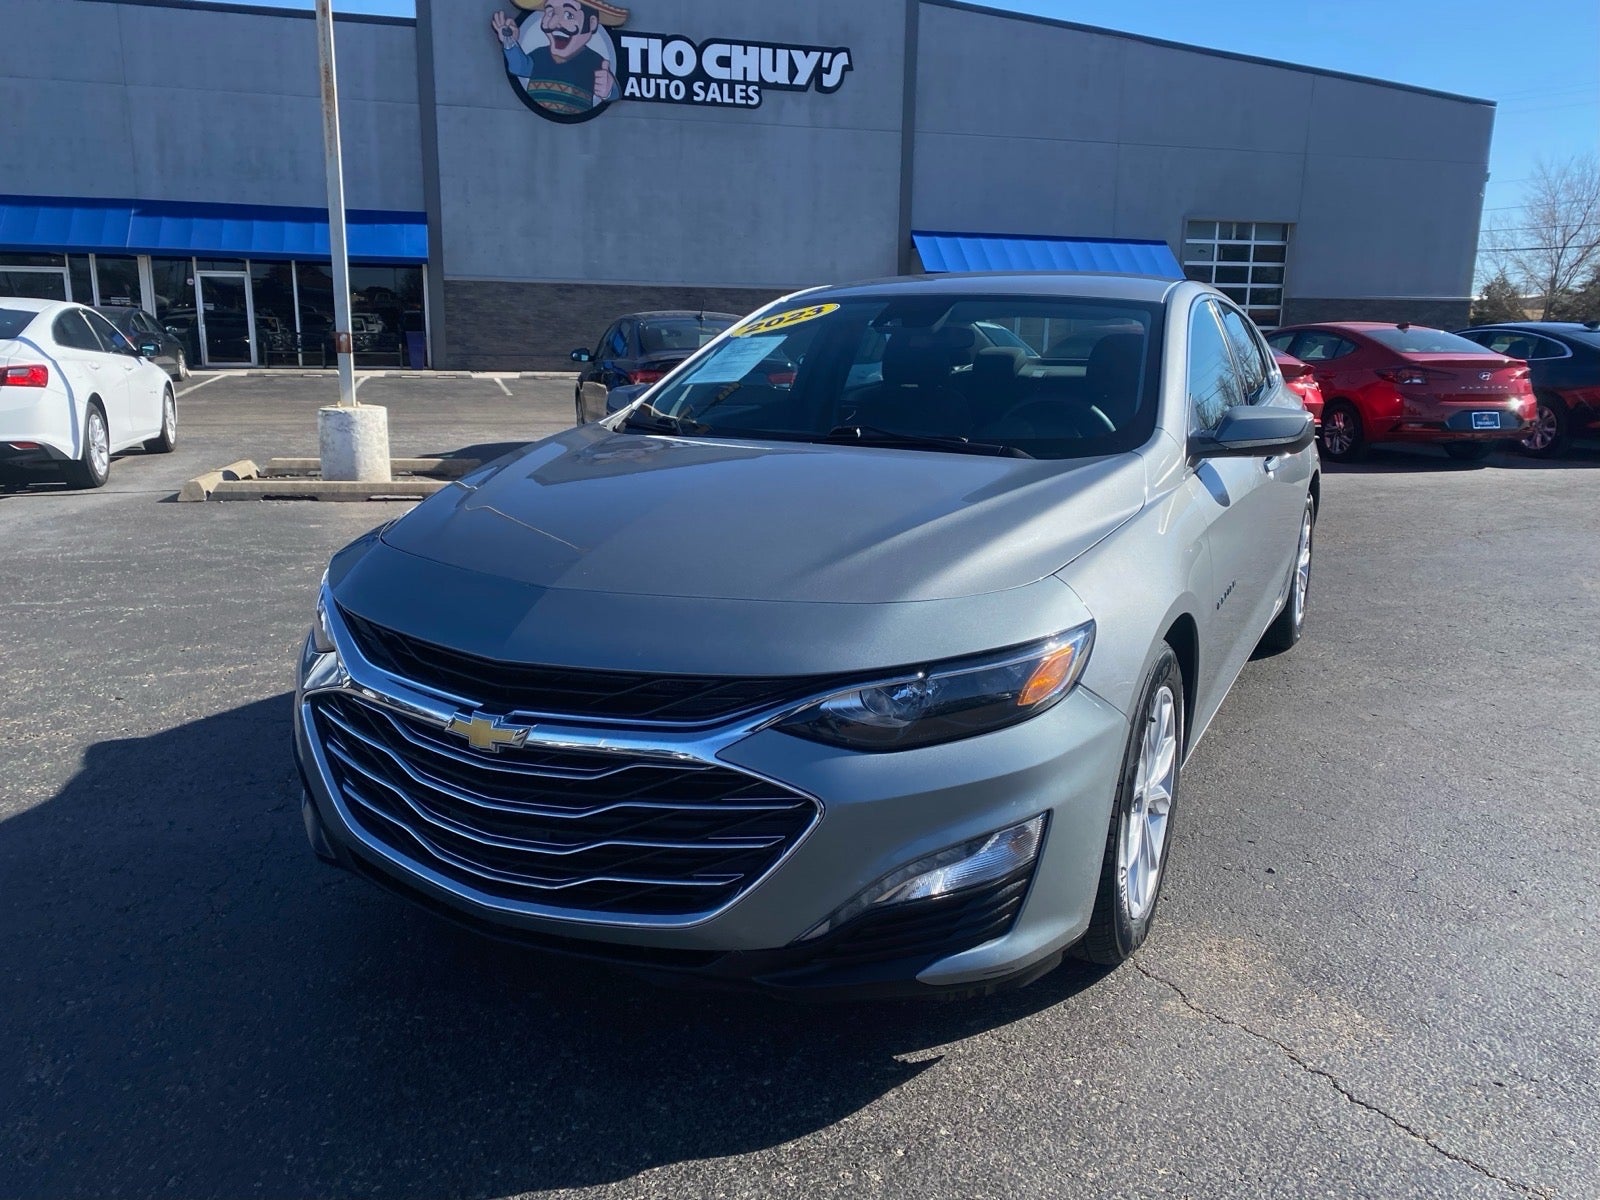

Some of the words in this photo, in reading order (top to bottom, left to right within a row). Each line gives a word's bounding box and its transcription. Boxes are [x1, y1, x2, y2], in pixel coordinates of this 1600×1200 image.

[620, 35, 697, 77] TIO
[702, 43, 849, 87] CHUY'S
[624, 77, 686, 101] AUTO
[692, 81, 760, 106] SALES
[742, 306, 824, 333] 2023
